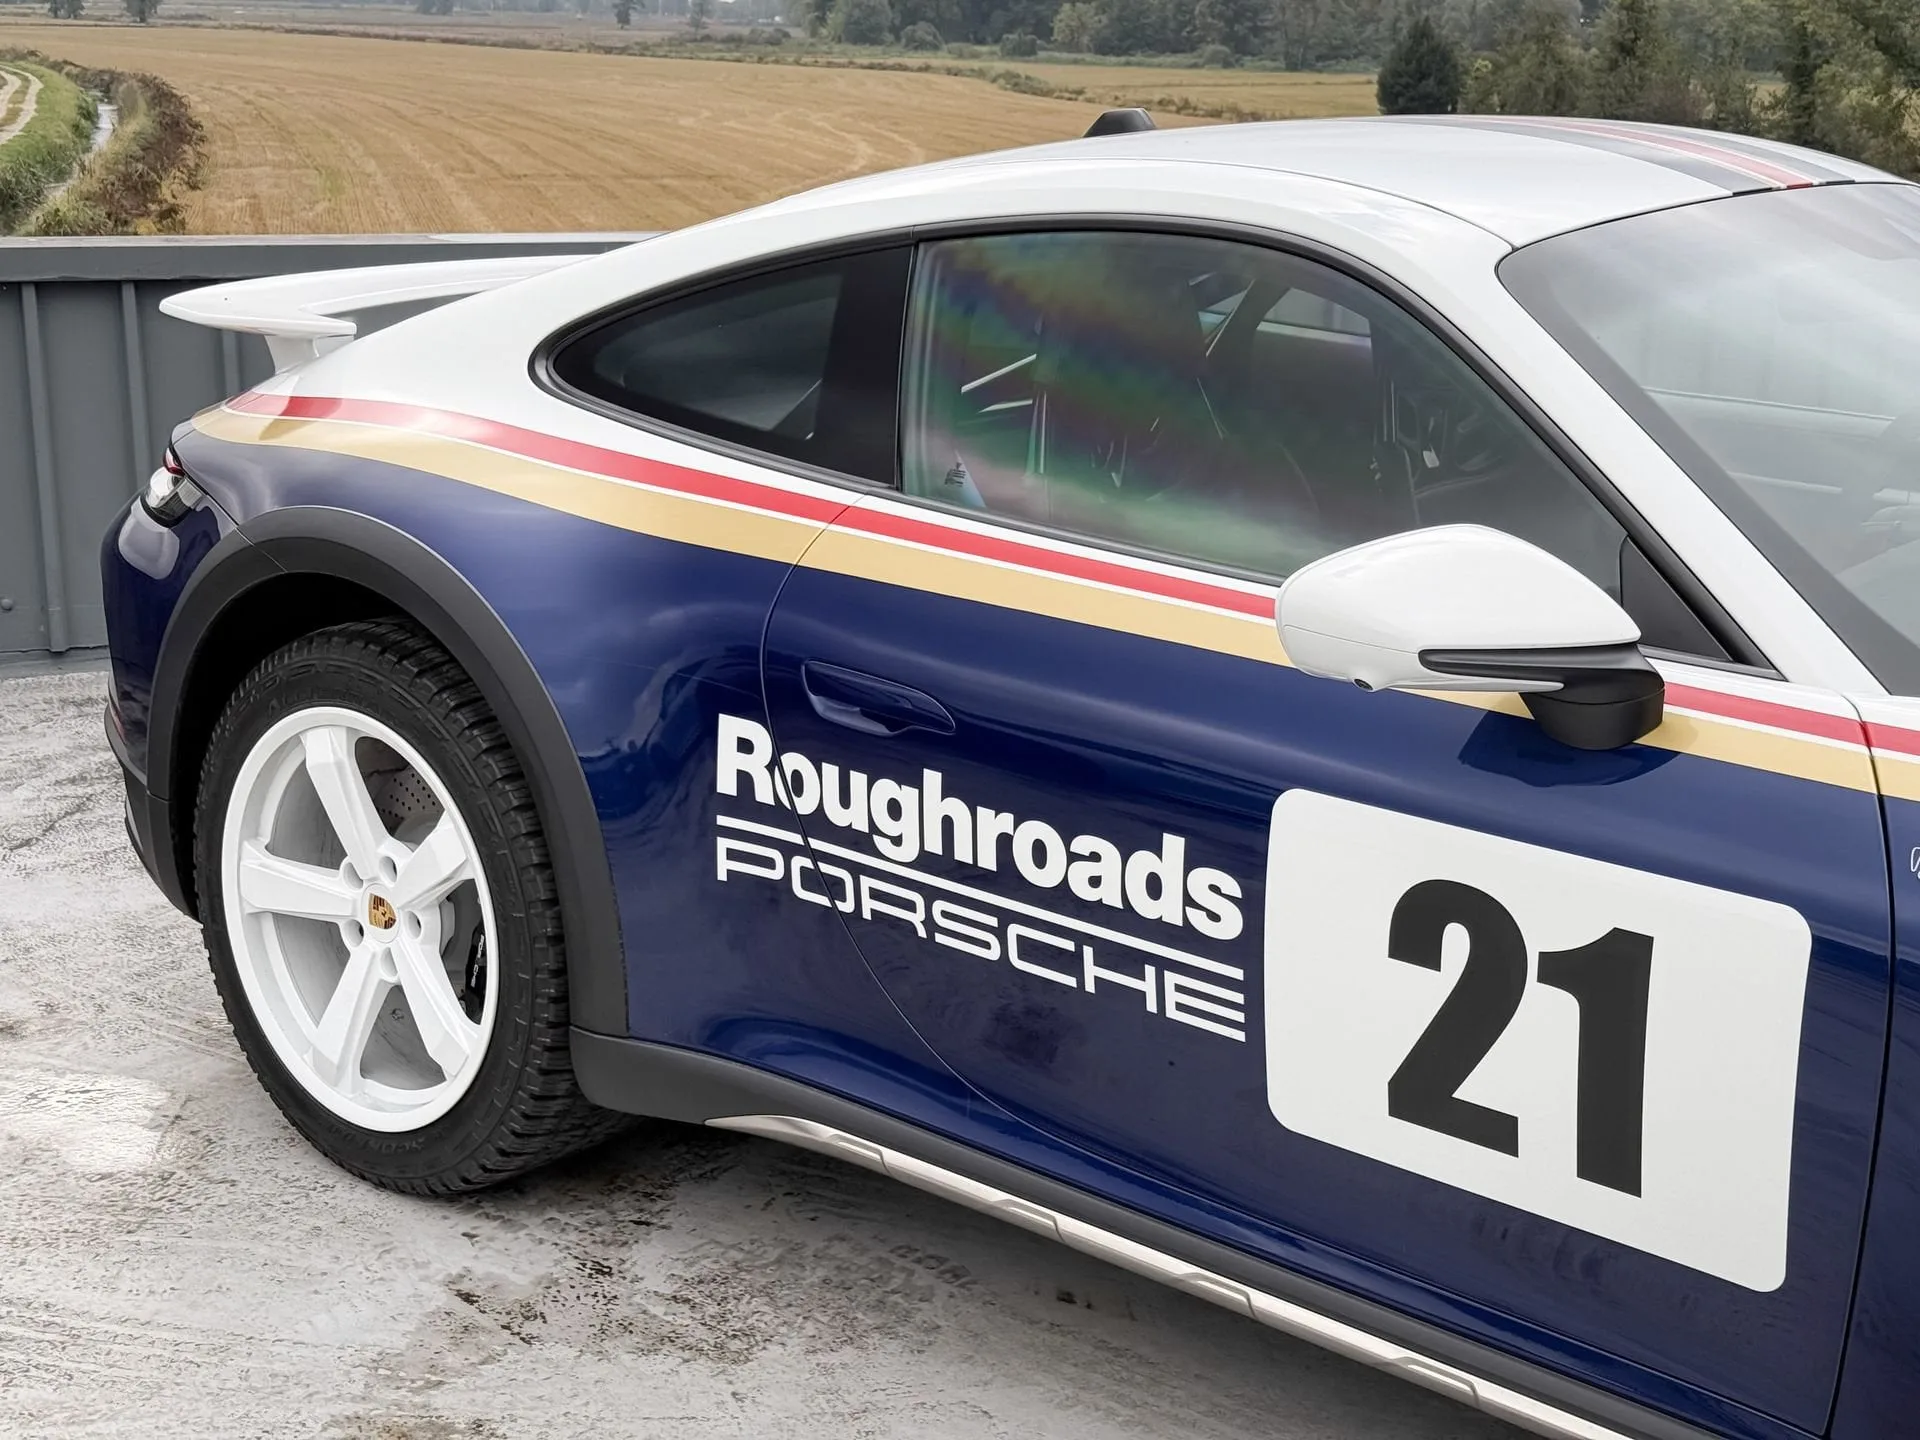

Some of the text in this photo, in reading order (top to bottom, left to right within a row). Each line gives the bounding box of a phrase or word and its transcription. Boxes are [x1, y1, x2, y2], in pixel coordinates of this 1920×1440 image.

[716, 713, 1243, 940] Roughroads
[470, 934, 485, 988] PORCHE
[716, 836, 1246, 1042] PORSCHE
[1387, 879, 1654, 1199] 21
